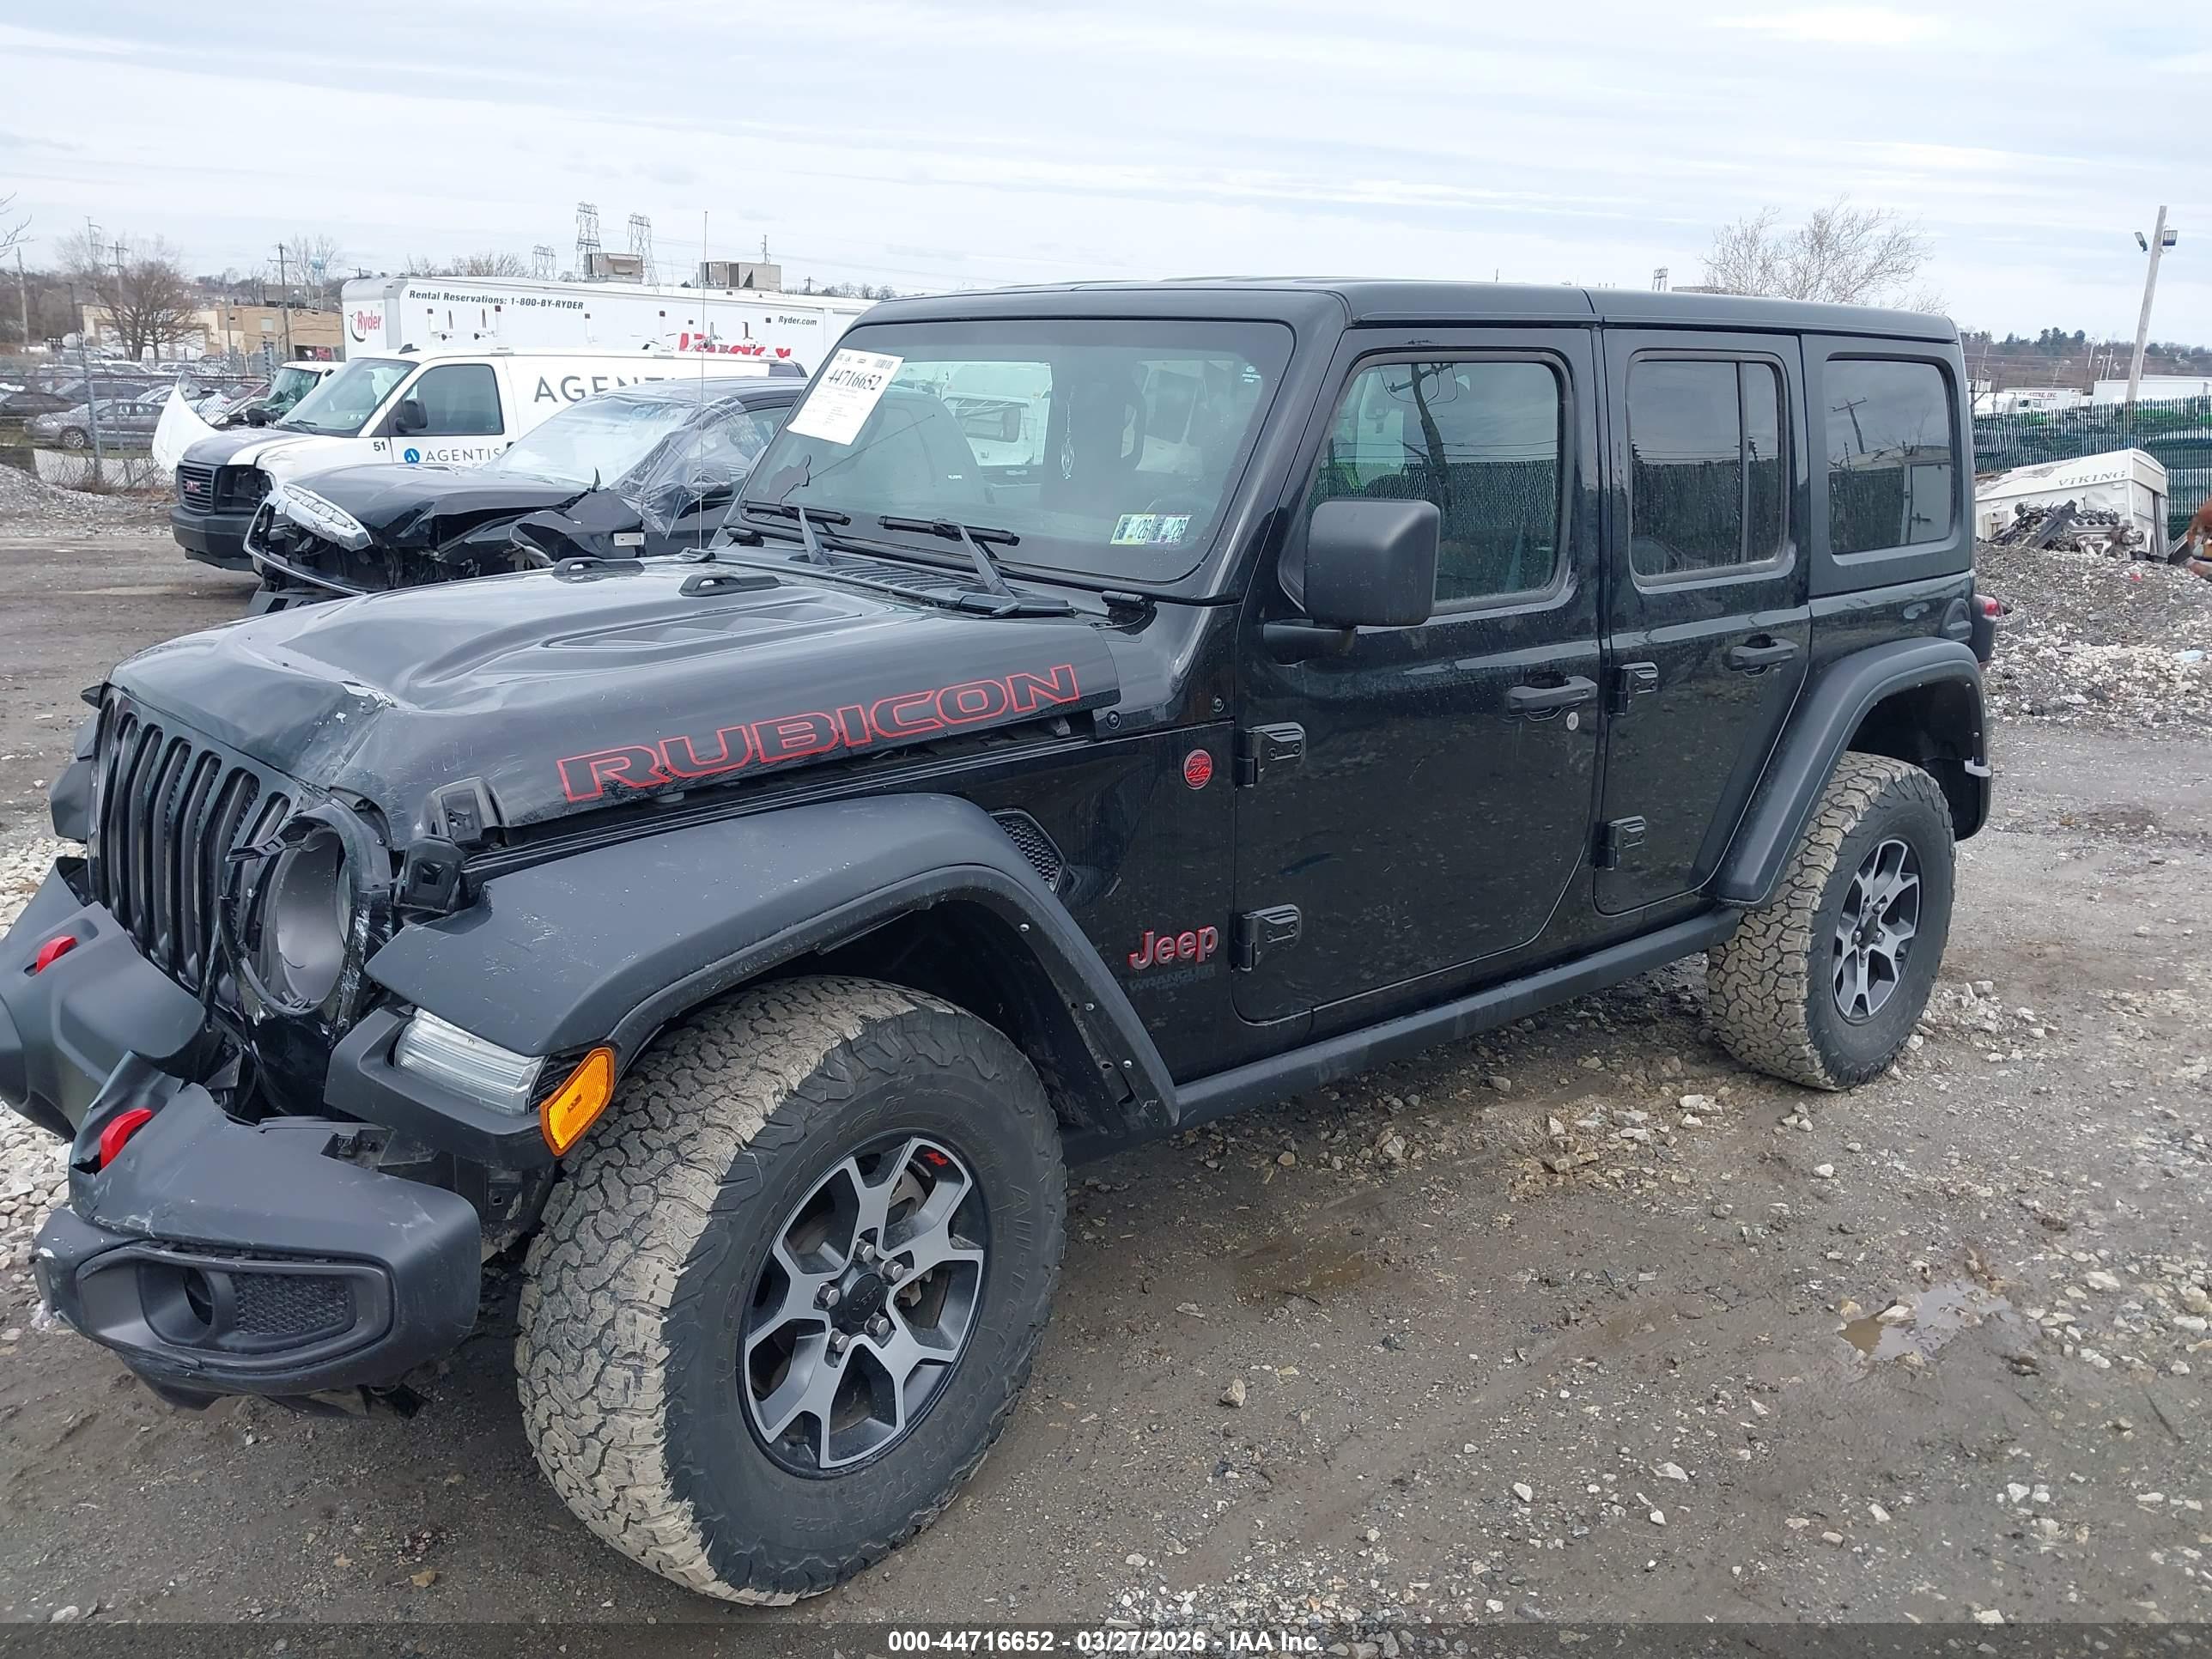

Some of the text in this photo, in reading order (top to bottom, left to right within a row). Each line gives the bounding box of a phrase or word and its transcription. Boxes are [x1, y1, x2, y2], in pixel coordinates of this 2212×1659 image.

[410, 289, 584, 310] Rental Reservations: 1-800-BY-RYDER
[357, 309, 382, 336] Ryder
[778, 315, 817, 325] Ryder.com
[828, 368, 883, 391] 44716652
[373, 441, 386, 452] 51
[2058, 470, 2126, 487] VIKING
[556, 664, 1081, 802] RUBICON
[1127, 926, 1219, 970] Jeep
